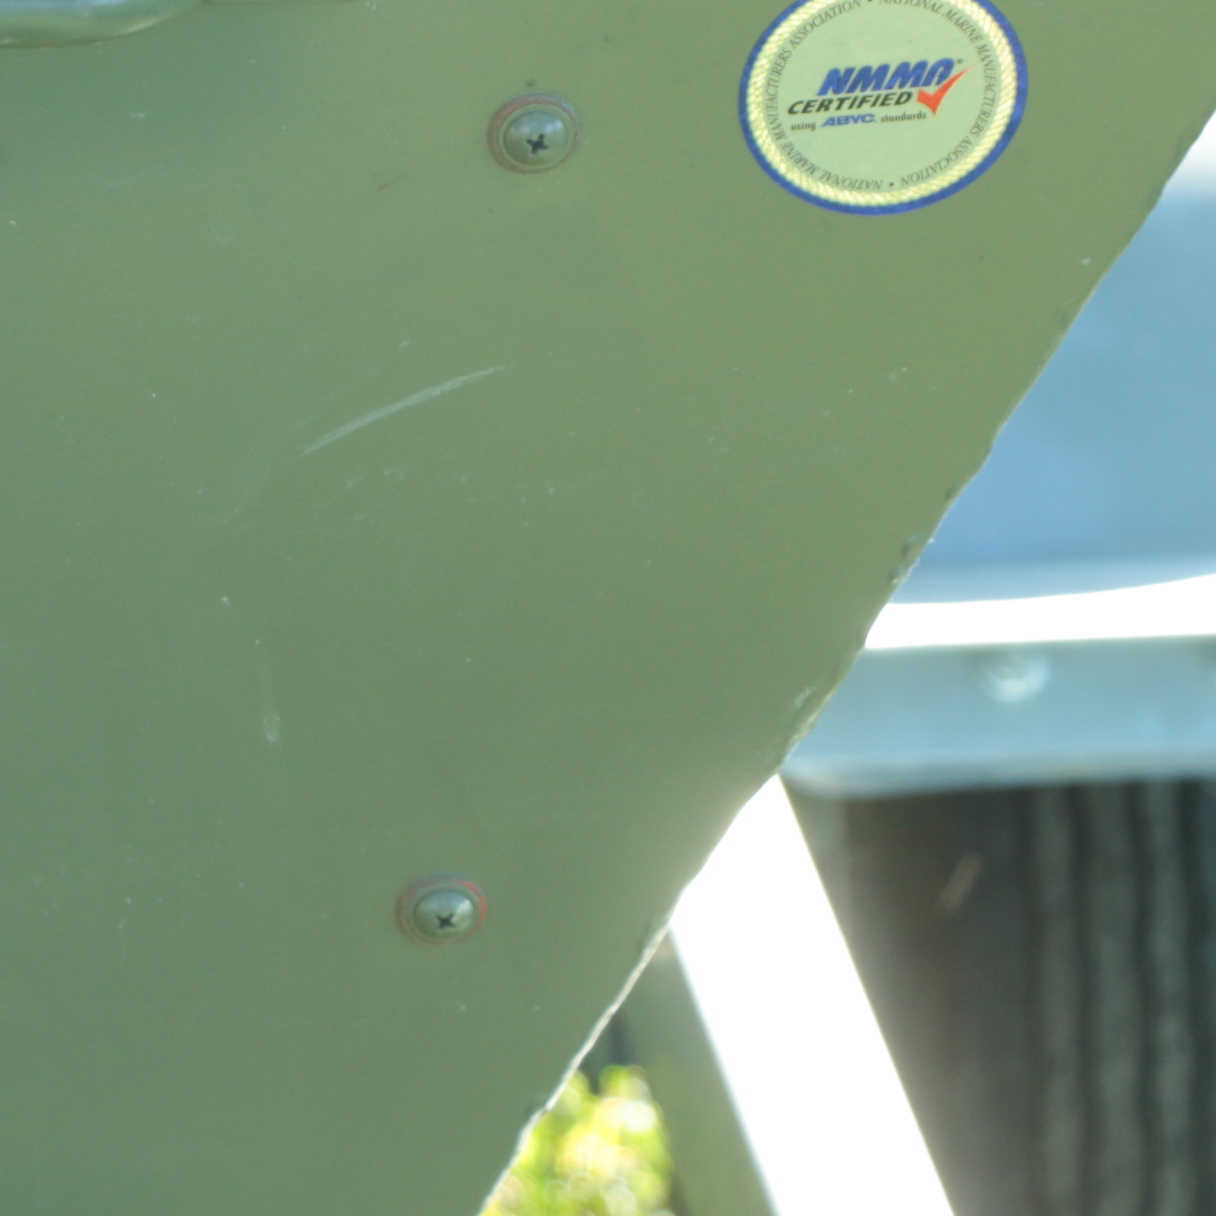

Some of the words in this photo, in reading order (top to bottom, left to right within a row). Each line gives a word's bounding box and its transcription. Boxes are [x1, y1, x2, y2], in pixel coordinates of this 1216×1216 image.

[943, 8, 982, 44] MARINE
[766, 48, 792, 139] MANUFACTURERS
[787, 91, 913, 115] CERTIFIED
[969, 43, 997, 138] MANUFACTURERS
[791, 121, 817, 131] using
[880, 111, 926, 122] standards
[781, 136, 820, 174] MARINE
[900, 136, 973, 186] ASSOCIATION
[819, 168, 883, 190] NATIONAL
